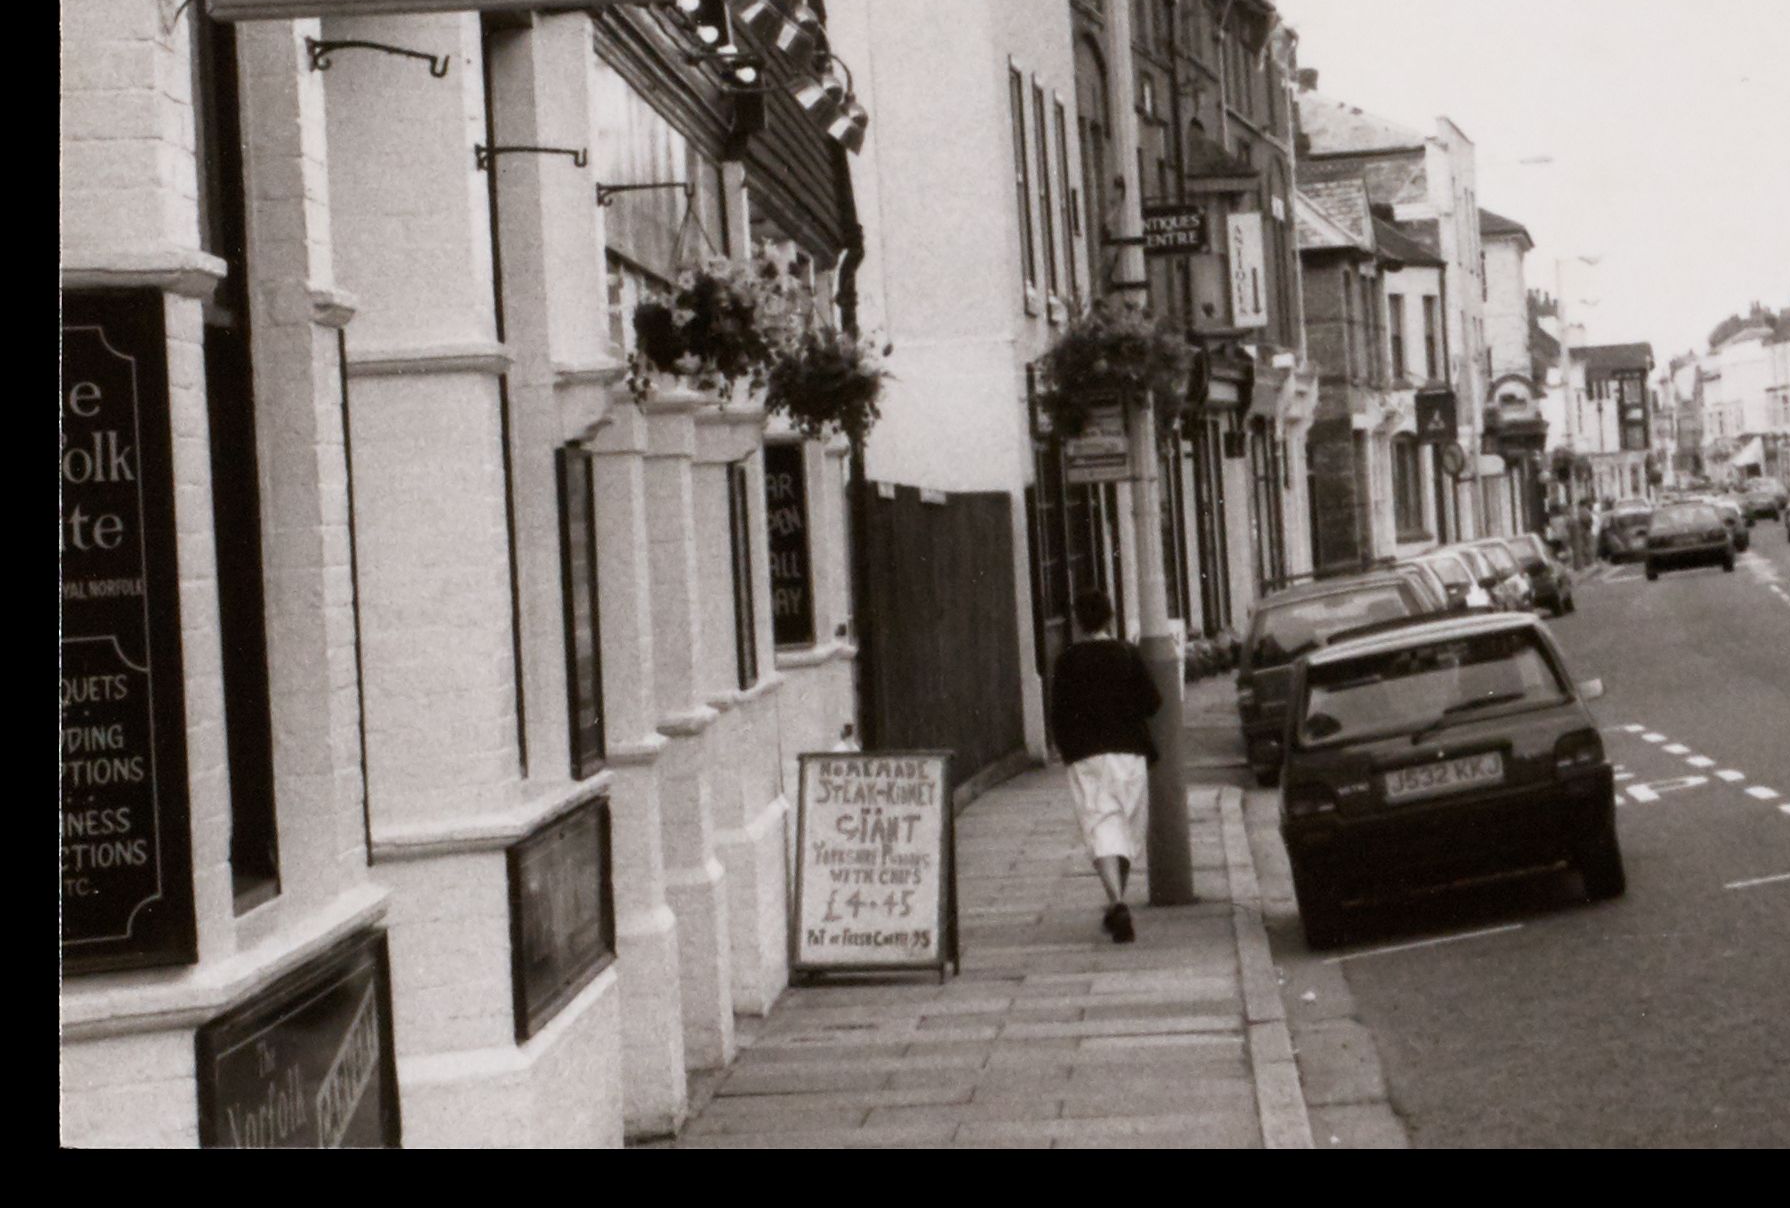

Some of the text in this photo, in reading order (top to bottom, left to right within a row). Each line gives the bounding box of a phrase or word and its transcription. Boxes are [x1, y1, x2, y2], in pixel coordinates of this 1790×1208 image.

[62, 380, 102, 417] e
[61, 429, 136, 484] olk
[61, 503, 124, 551] te
[61, 724, 125, 754] DING
